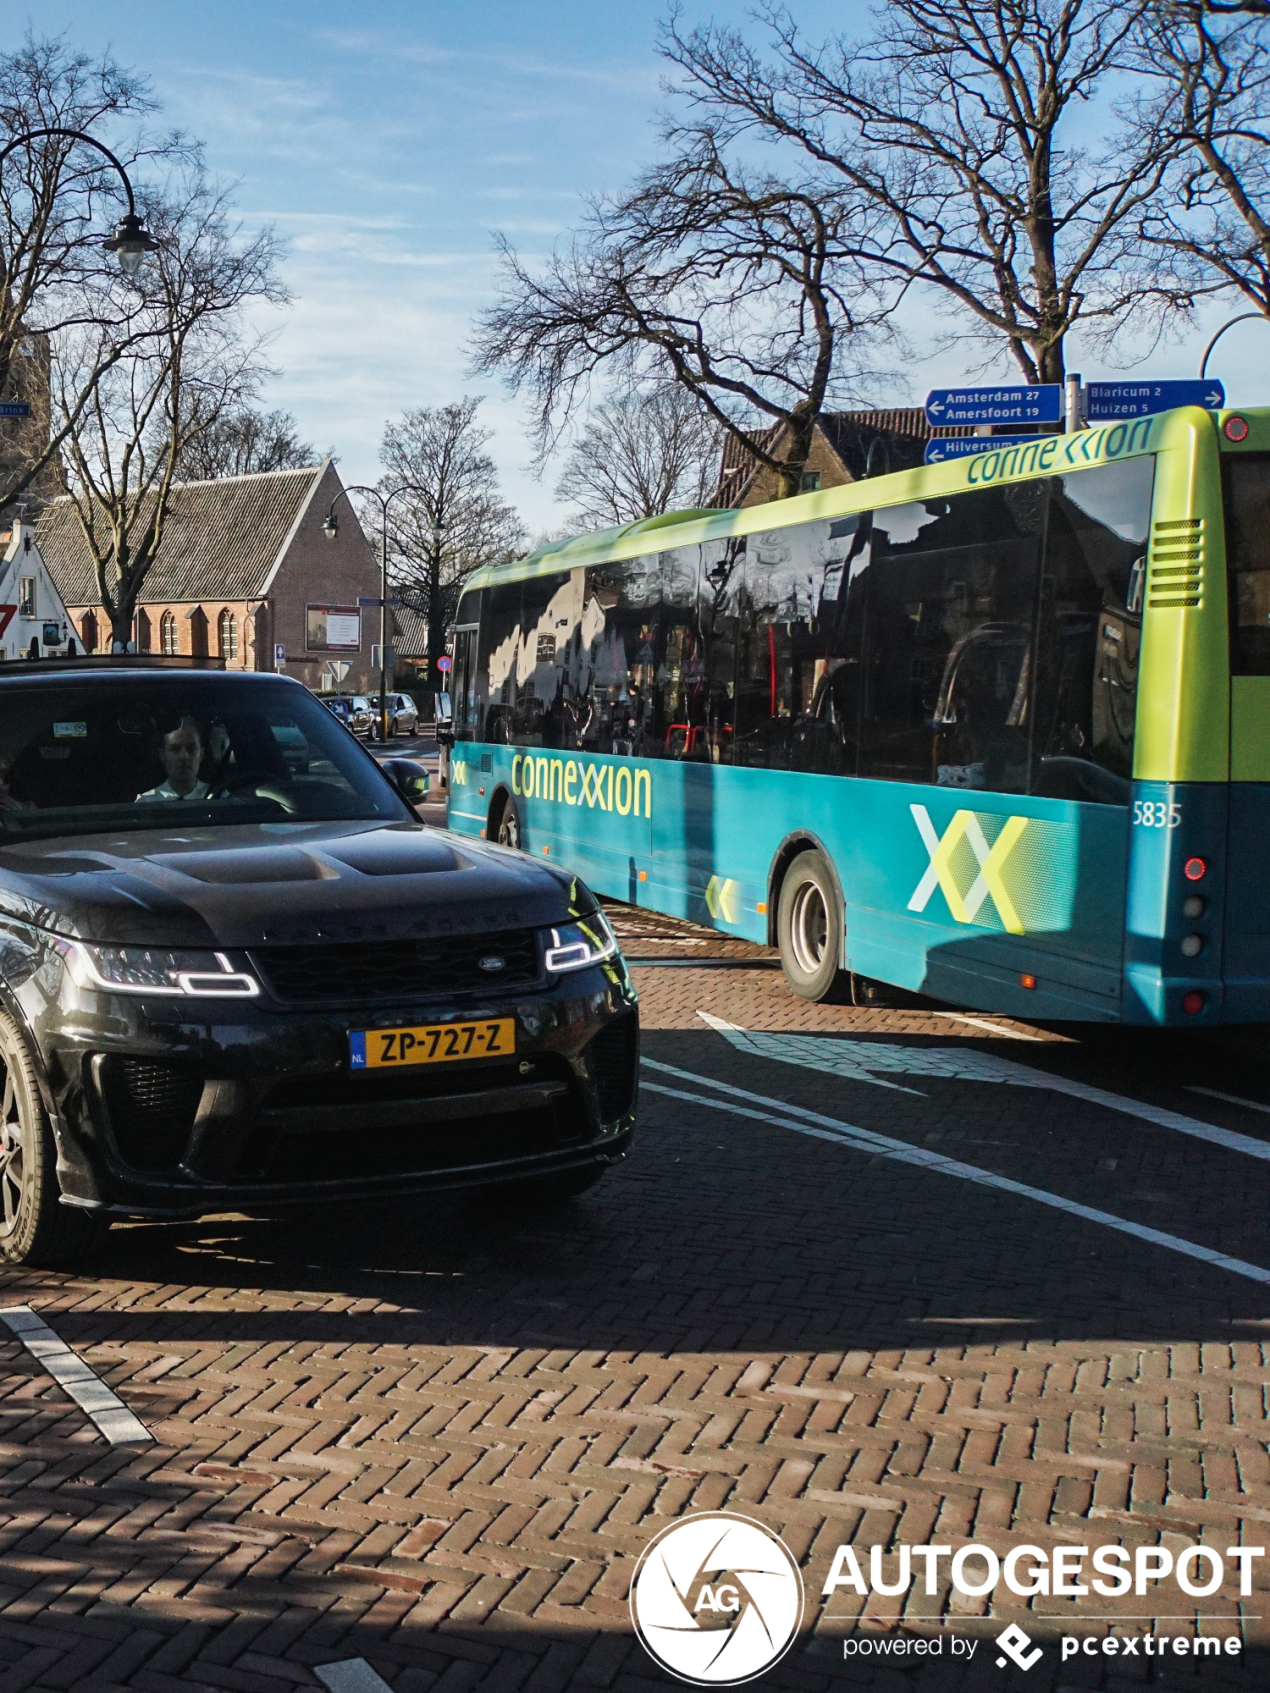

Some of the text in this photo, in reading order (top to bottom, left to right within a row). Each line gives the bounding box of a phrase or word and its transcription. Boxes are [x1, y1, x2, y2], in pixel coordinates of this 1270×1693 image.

[946, 390, 1040, 404] Amsterdam 27
[1091, 386, 1162, 398] Blaricum 2
[946, 405, 1040, 419] Amersfoort 19
[1091, 402, 1149, 414] Huizen 5
[511, 754, 651, 818] connexxion
[1133, 800, 1181, 828] 5835
[381, 1024, 501, 1063] ZP-727-Z
[352, 1055, 364, 1063] NL
